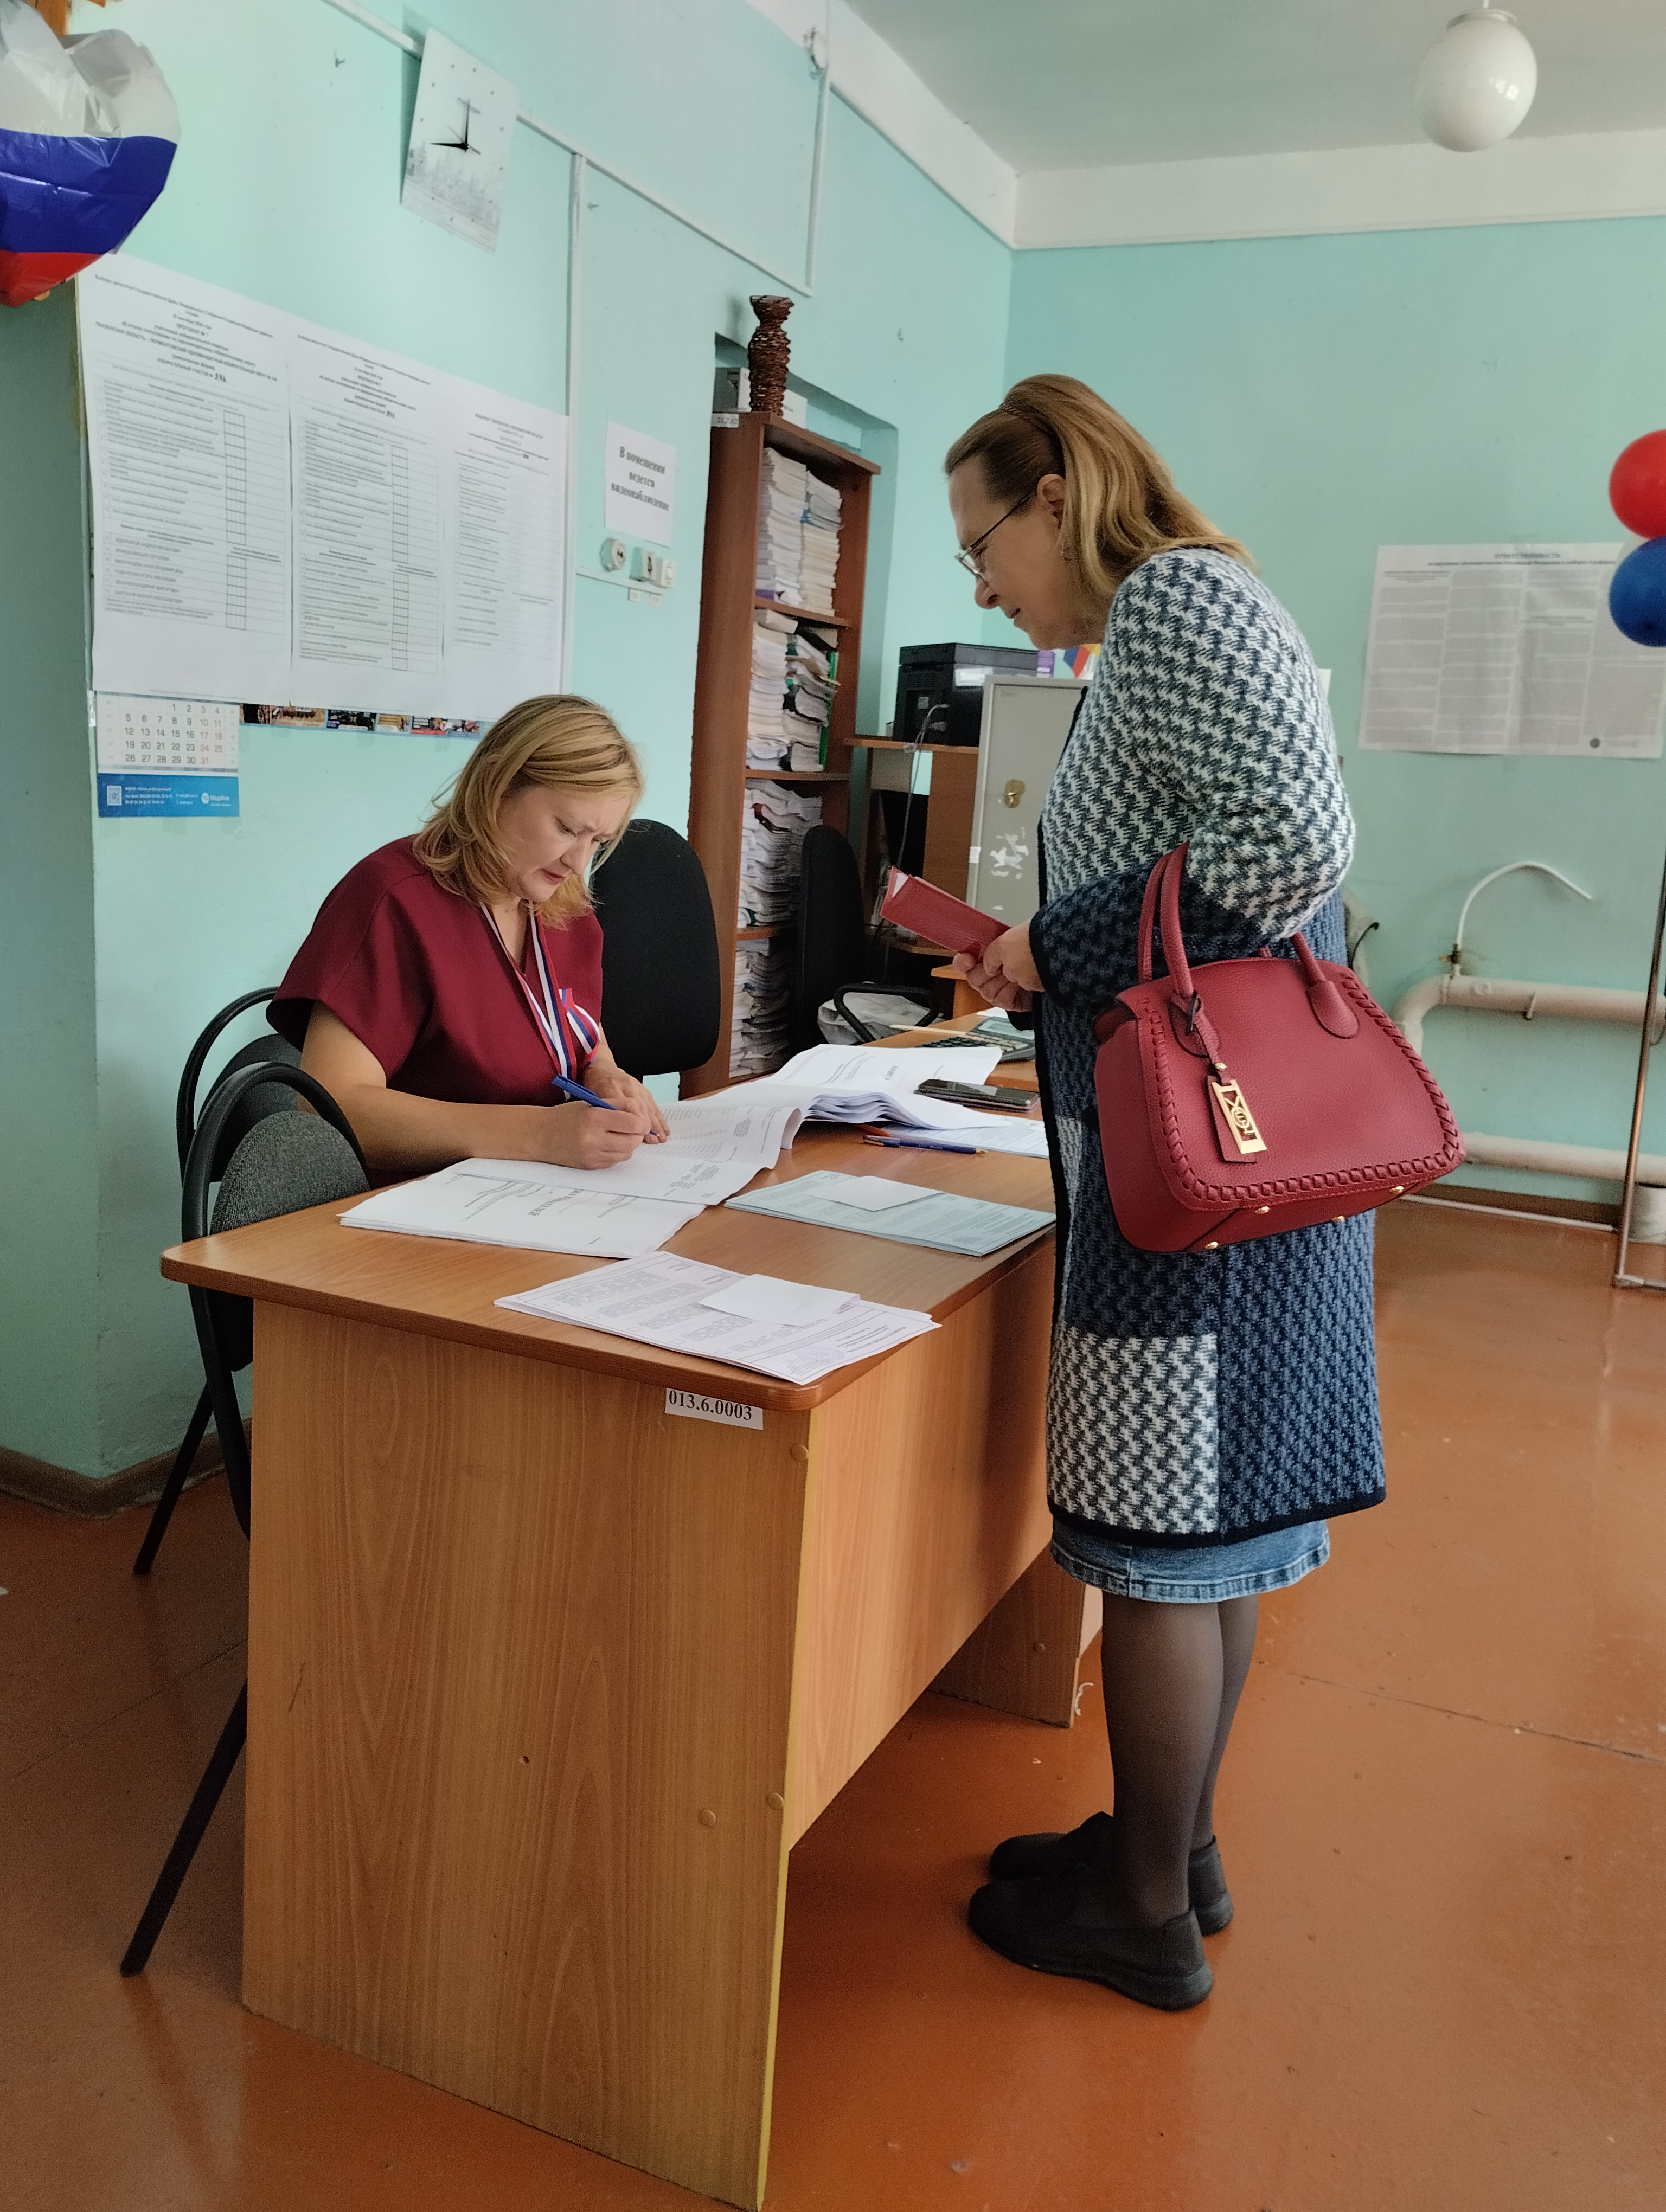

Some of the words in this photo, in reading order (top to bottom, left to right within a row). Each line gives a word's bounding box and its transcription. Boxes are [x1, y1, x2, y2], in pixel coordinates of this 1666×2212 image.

[619, 446, 625, 458] В
[626, 452, 665, 474] помещении
[629, 471, 655, 488] ведется
[611, 483, 669, 511] видеонаблюдение
[172, 703, 176, 711] 1
[186, 704, 191, 712] 2
[125, 713, 131, 722] 5
[142, 715, 147, 723] 6
[157, 715, 162, 724] 7
[172, 716, 177, 724] 8
[187, 717, 192, 725] 9
[200, 718, 208, 726] 10
[124, 727, 134, 735] 12
[140, 728, 150, 736] 13
[171, 729, 180, 737] 15
[185, 730, 195, 738] 16
[125, 740, 135, 749] 19
[140, 741, 151, 750] 20
[156, 742, 165, 750] 21
[171, 742, 181, 751] 22
[185, 743, 195, 751] 23
[200, 744, 209, 752] 24
[214, 744, 223, 753] 25
[125, 754, 136, 762] 26
[141, 754, 151, 763] 27
[156, 755, 166, 763] 28
[171, 755, 181, 764] 29
[186, 756, 196, 764] 30
[200, 757, 209, 765] 31
[669, 1390, 752, 1420] 013.6.0003
